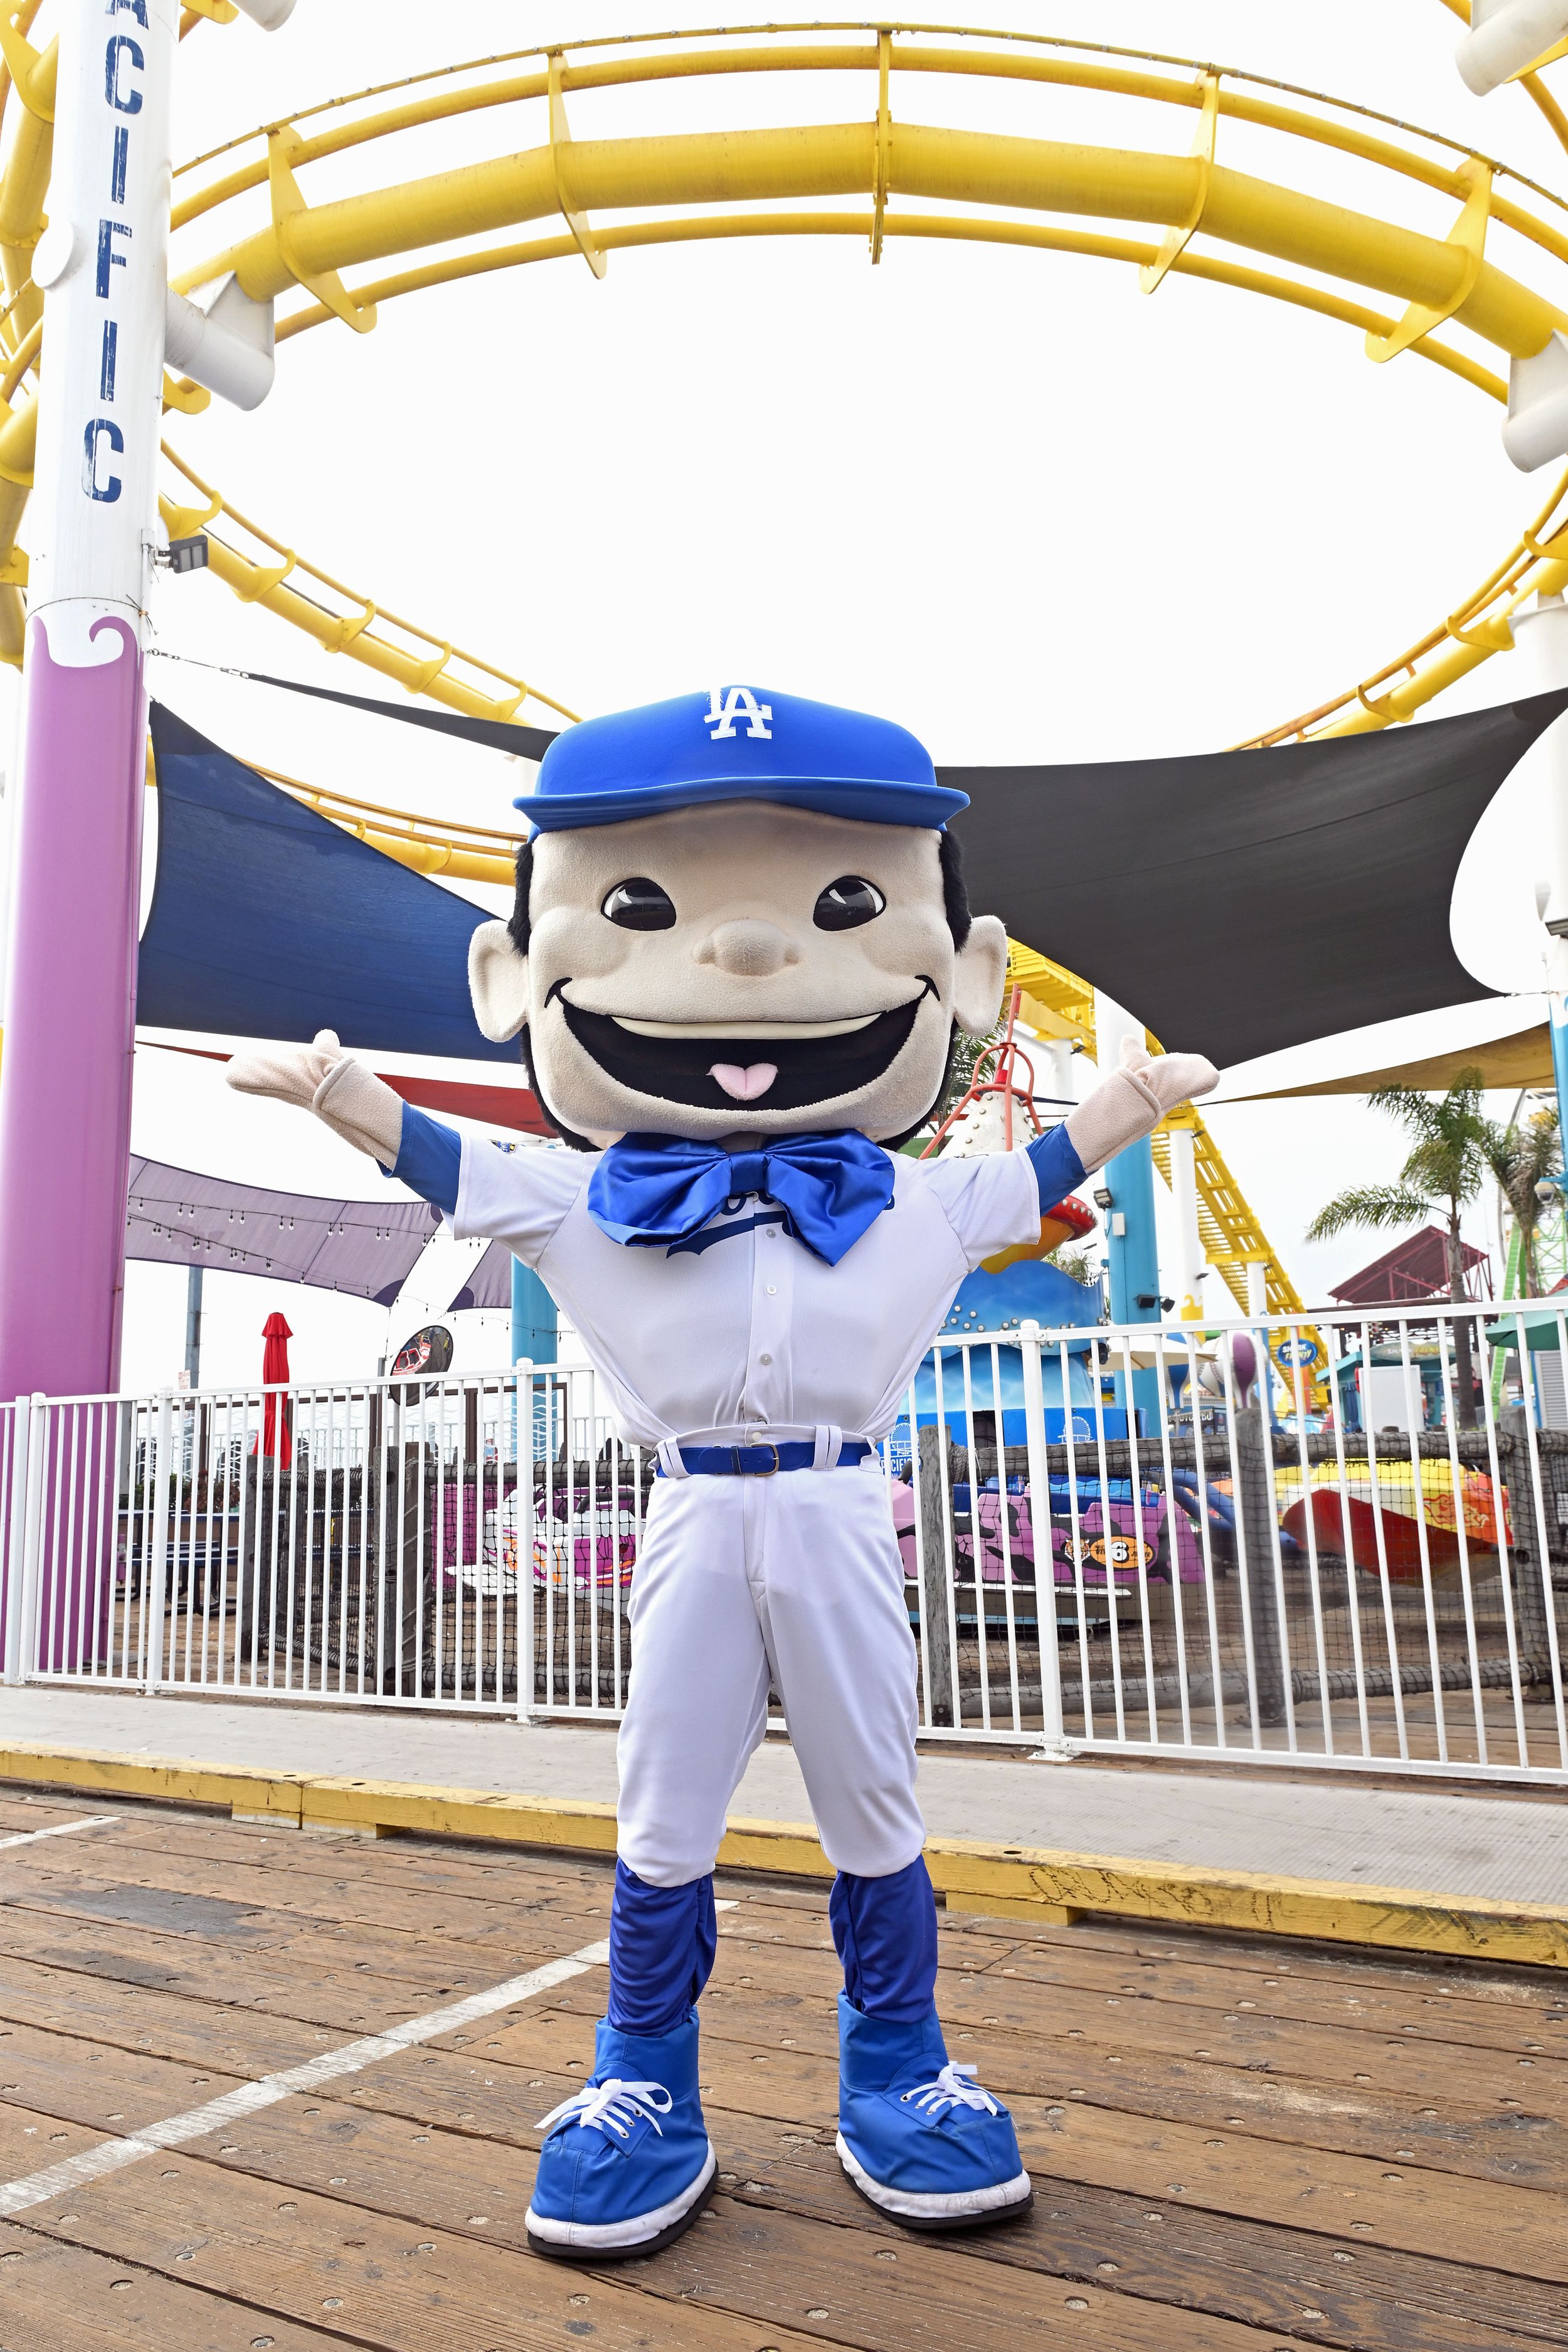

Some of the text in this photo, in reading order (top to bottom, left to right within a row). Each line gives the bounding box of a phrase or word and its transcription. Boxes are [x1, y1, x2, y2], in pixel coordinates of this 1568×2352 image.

[703, 687, 773, 740] LA
[1283, 1344, 1306, 1353] SHRK
[1110, 1541, 1130, 1563] 6
